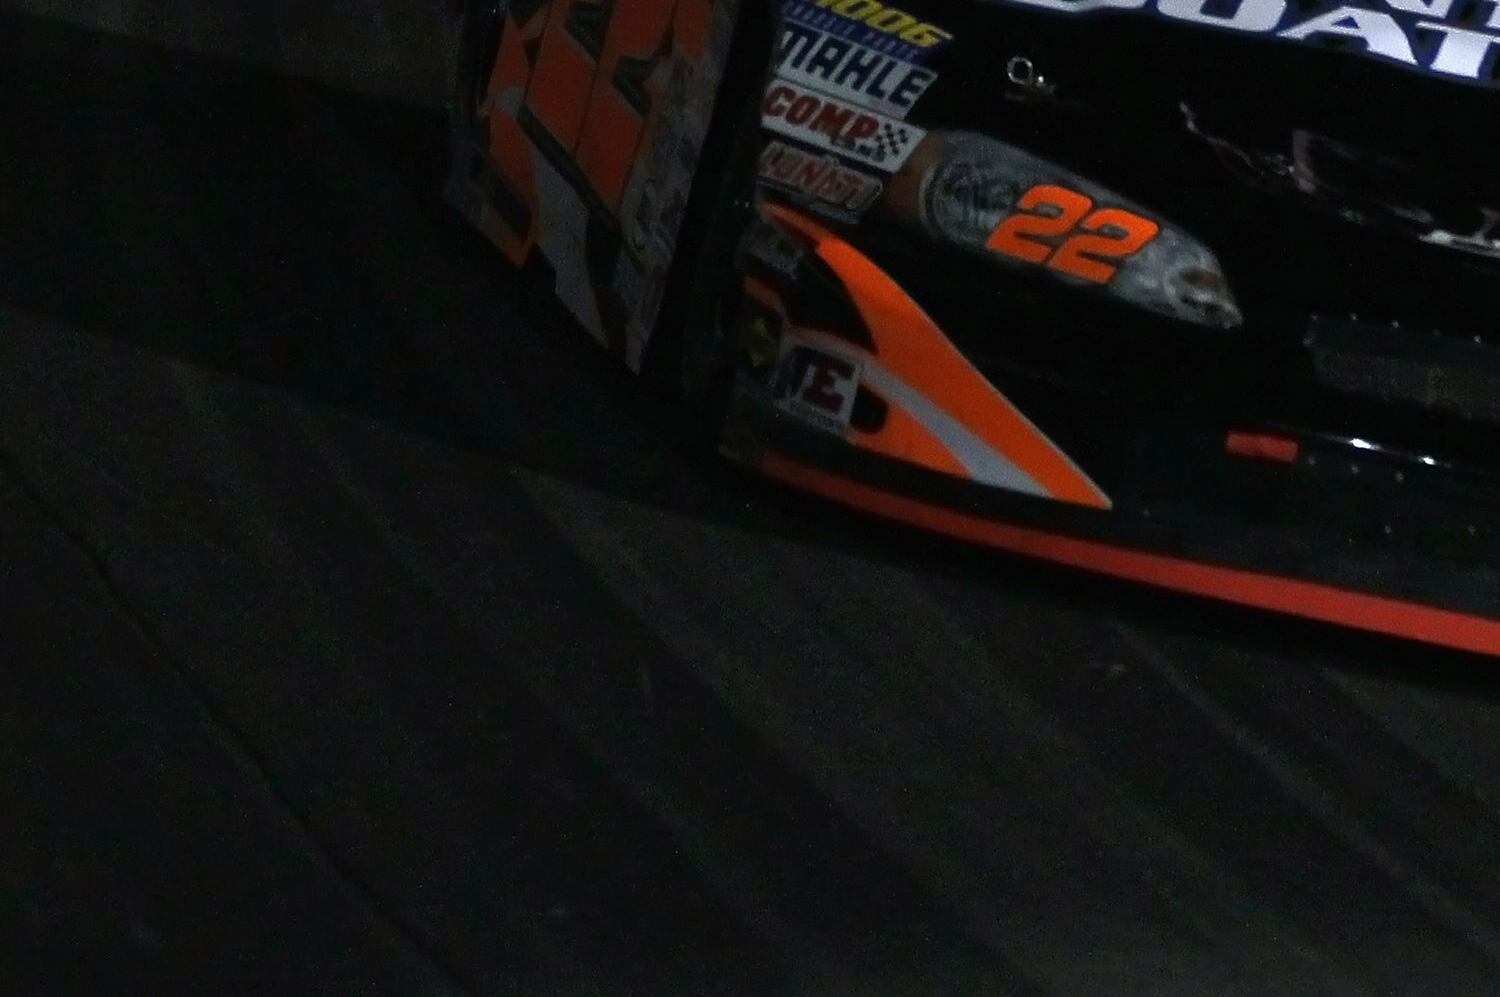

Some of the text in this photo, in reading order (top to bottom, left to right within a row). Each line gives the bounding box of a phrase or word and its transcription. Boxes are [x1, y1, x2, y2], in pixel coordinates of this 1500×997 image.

[776, 22, 932, 107] MAHLE
[762, 86, 880, 144] COMP
[986, 184, 1160, 285] 22
